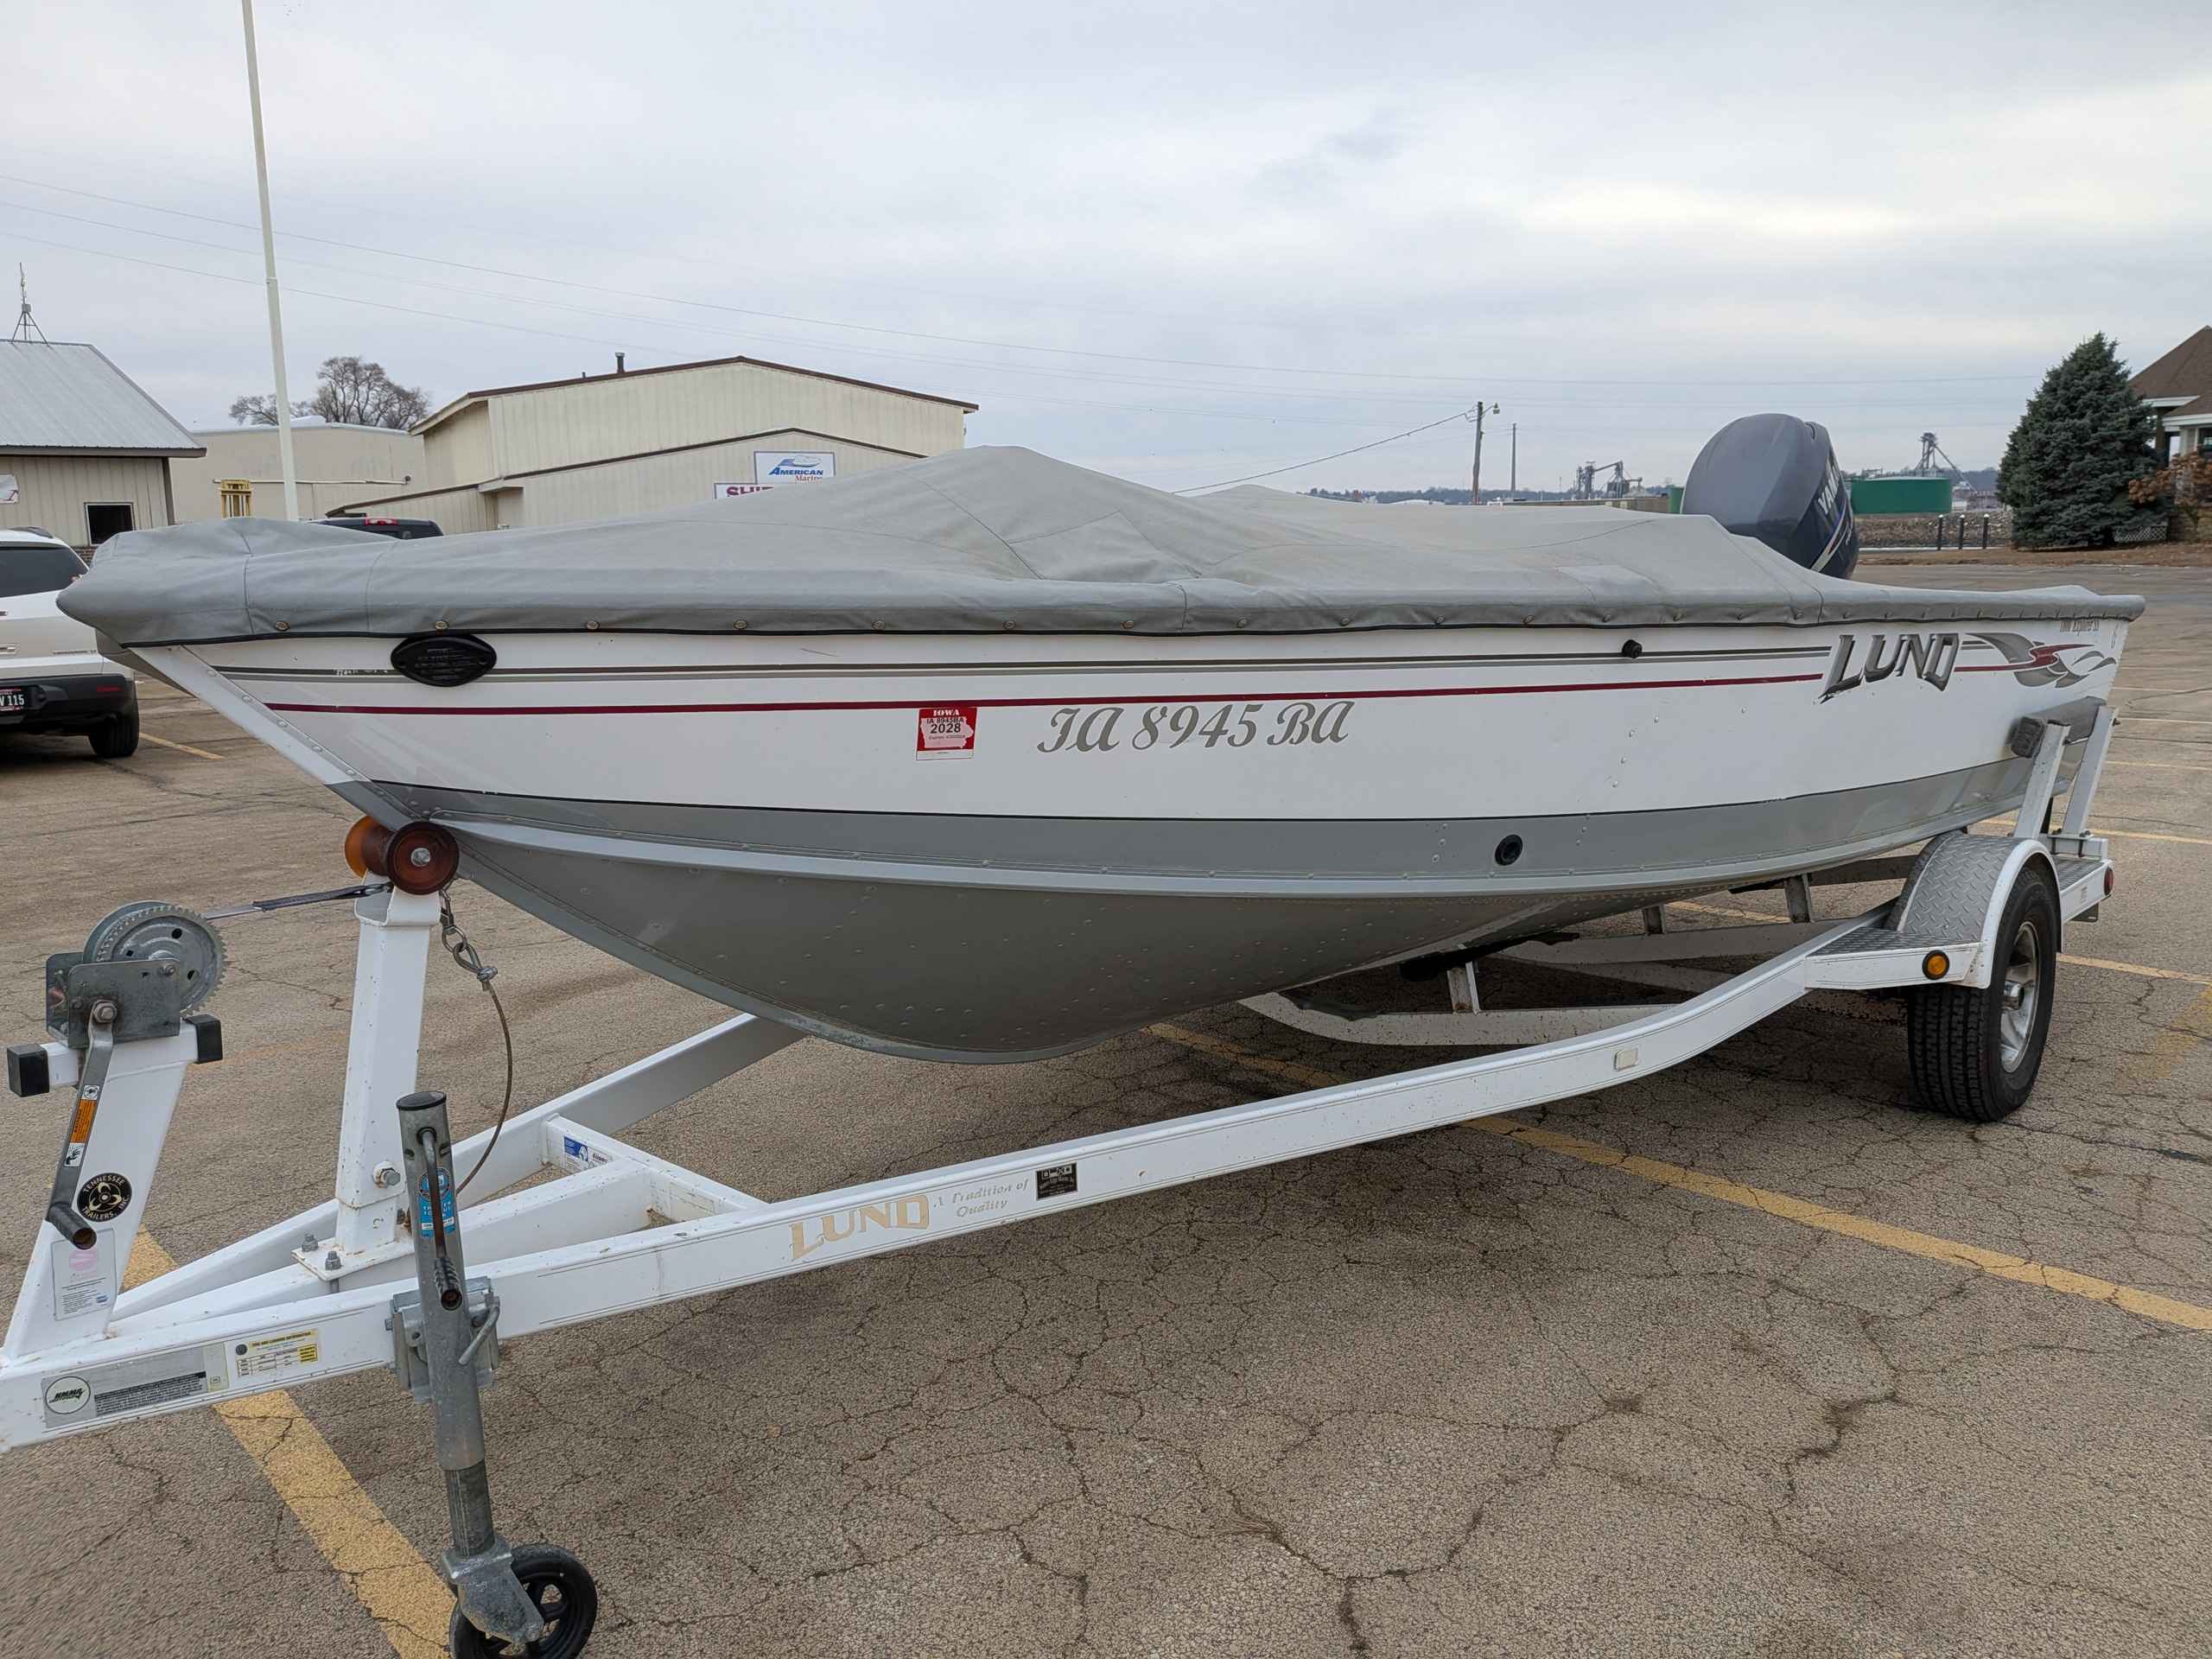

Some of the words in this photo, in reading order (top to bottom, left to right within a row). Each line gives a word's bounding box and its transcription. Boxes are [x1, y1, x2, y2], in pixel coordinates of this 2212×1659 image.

[768, 467, 824, 476] AMERICAN
[1818, 632, 1960, 704] LUND
[7, 694, 25, 706] 115
[931, 722, 962, 734] 2028
[1037, 707, 1124, 753] IA
[1132, 703, 1264, 751] 8945
[1267, 701, 1356, 747] BA
[83, 1174, 125, 1192] TENNESSEE
[957, 1199, 1008, 1217] Quality
[789, 1194, 931, 1260] LUND
[952, 1185, 1012, 1204] Tradition
[1016, 1178, 1029, 1192] of
